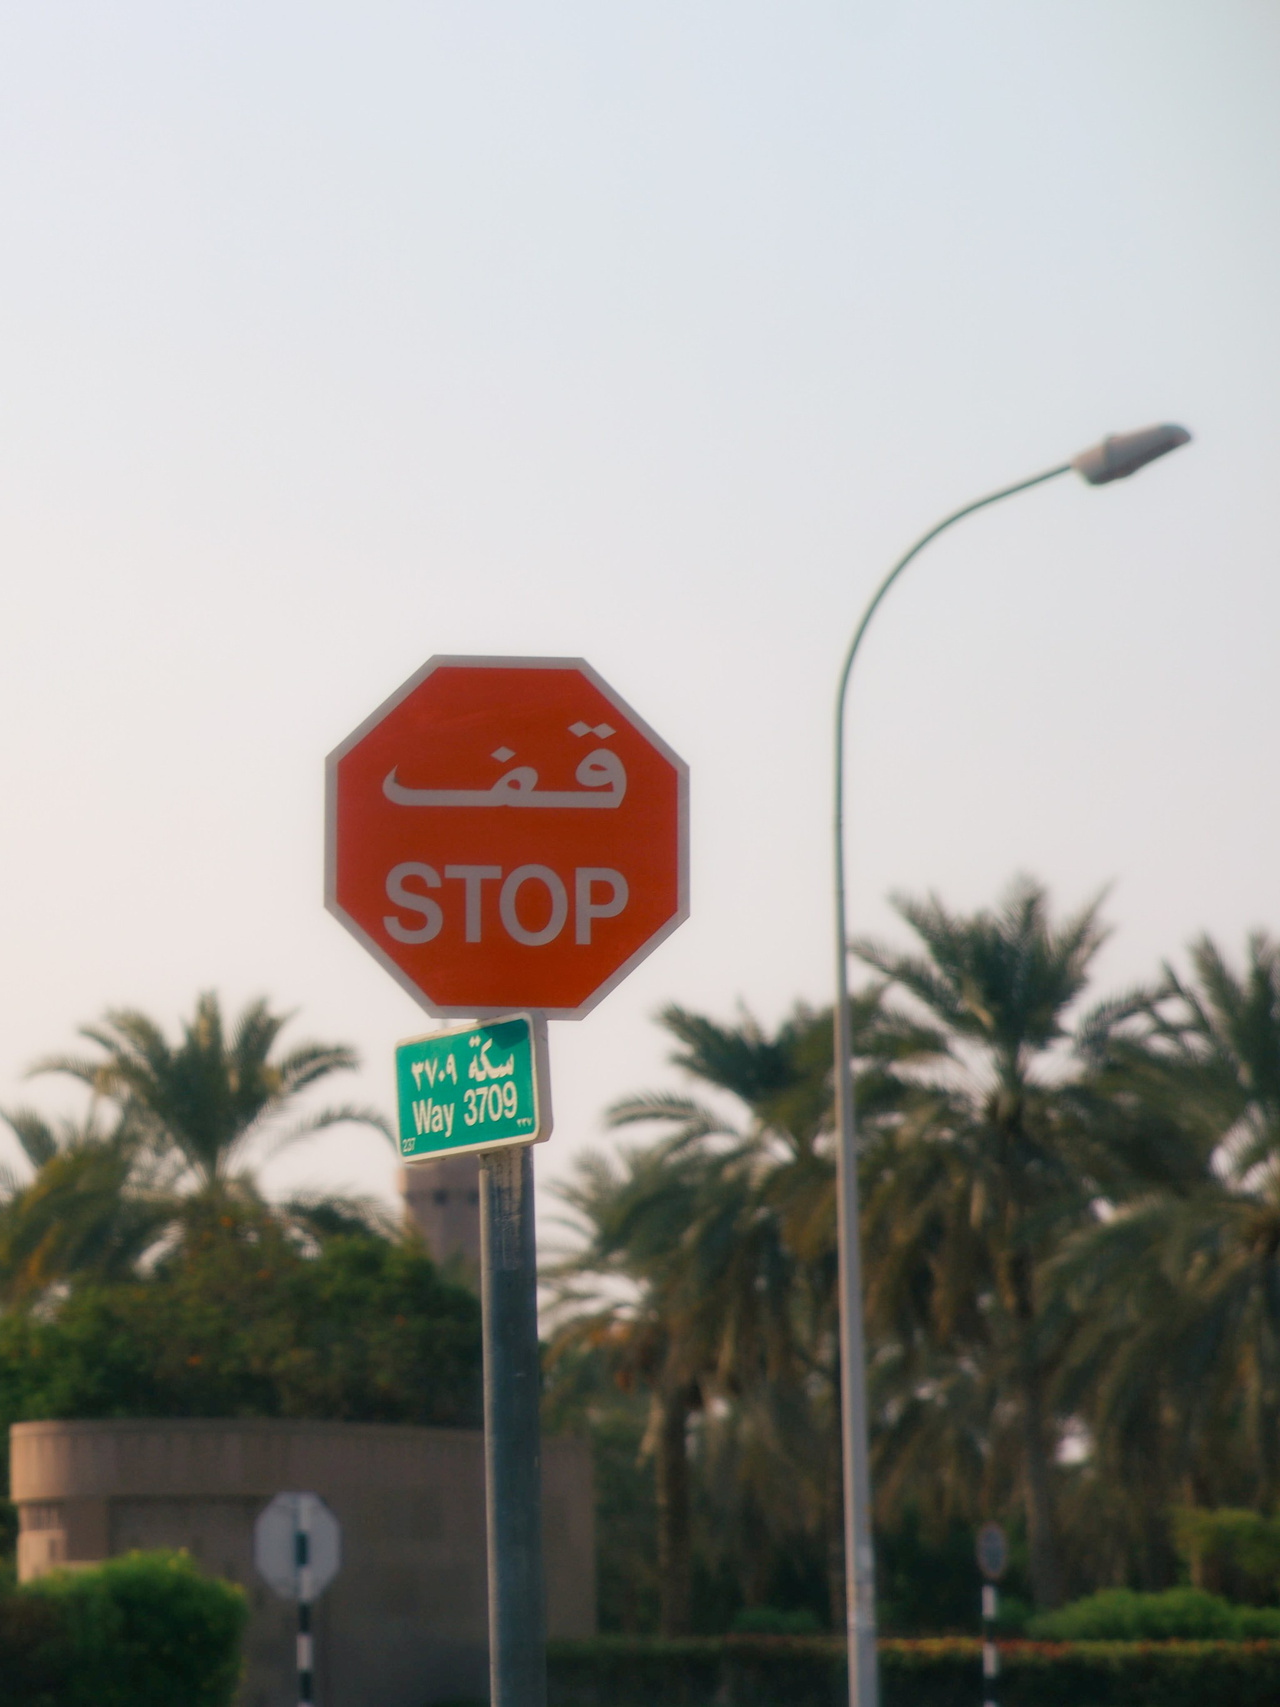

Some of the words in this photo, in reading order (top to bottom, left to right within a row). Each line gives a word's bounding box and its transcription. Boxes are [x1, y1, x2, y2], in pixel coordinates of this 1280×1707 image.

[382, 861, 630, 947] STOP
[411, 1052, 458, 1091] ٣٧٠٩
[468, 1035, 515, 1082] سكة
[412, 1097, 455, 1138] Way
[463, 1081, 518, 1127] 3709
